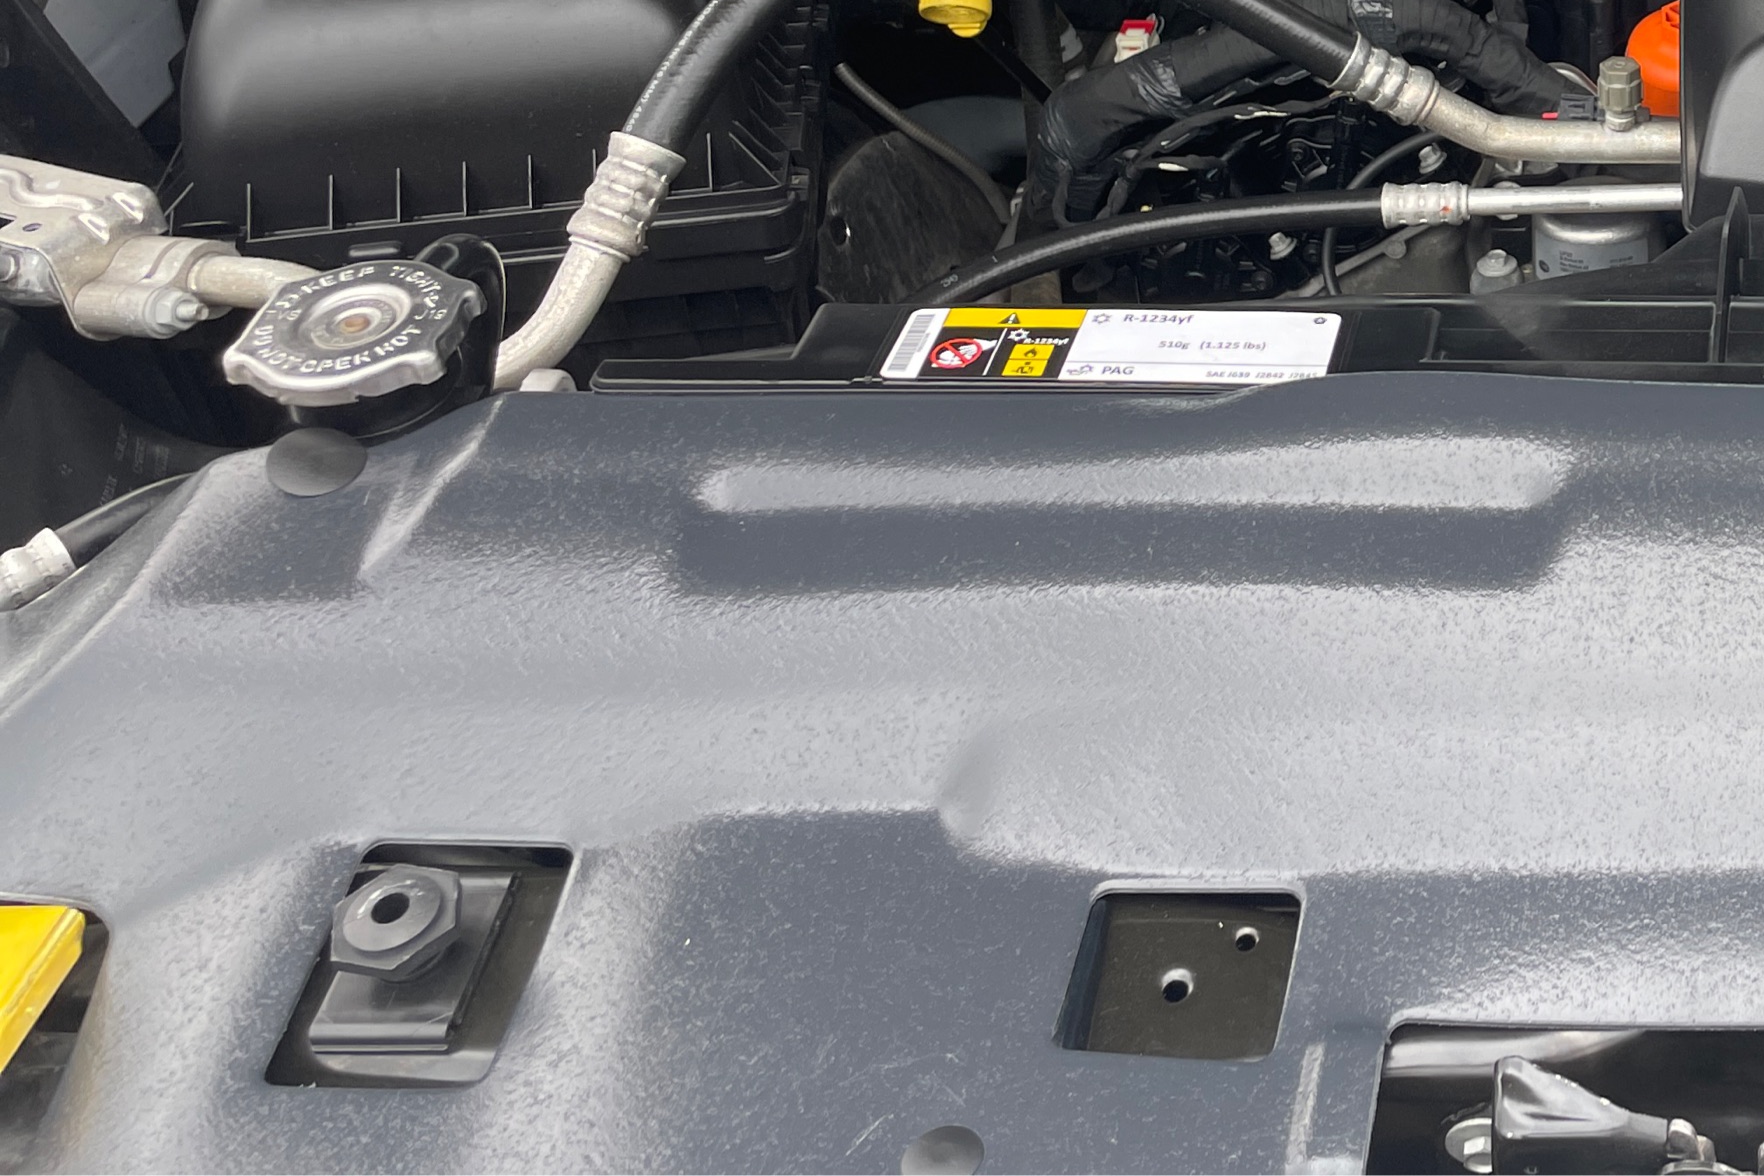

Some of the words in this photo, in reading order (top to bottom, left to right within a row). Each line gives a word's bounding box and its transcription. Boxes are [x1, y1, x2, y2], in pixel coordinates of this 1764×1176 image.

[1123, 313, 1195, 325] R-1234yf
[1158, 340, 1190, 350] 510g
[1199, 340, 1240, 350] (1.125
[1242, 340, 1267, 351] lbs)
[1101, 366, 1135, 375] PAG
[1205, 370, 1226, 378] SAE
